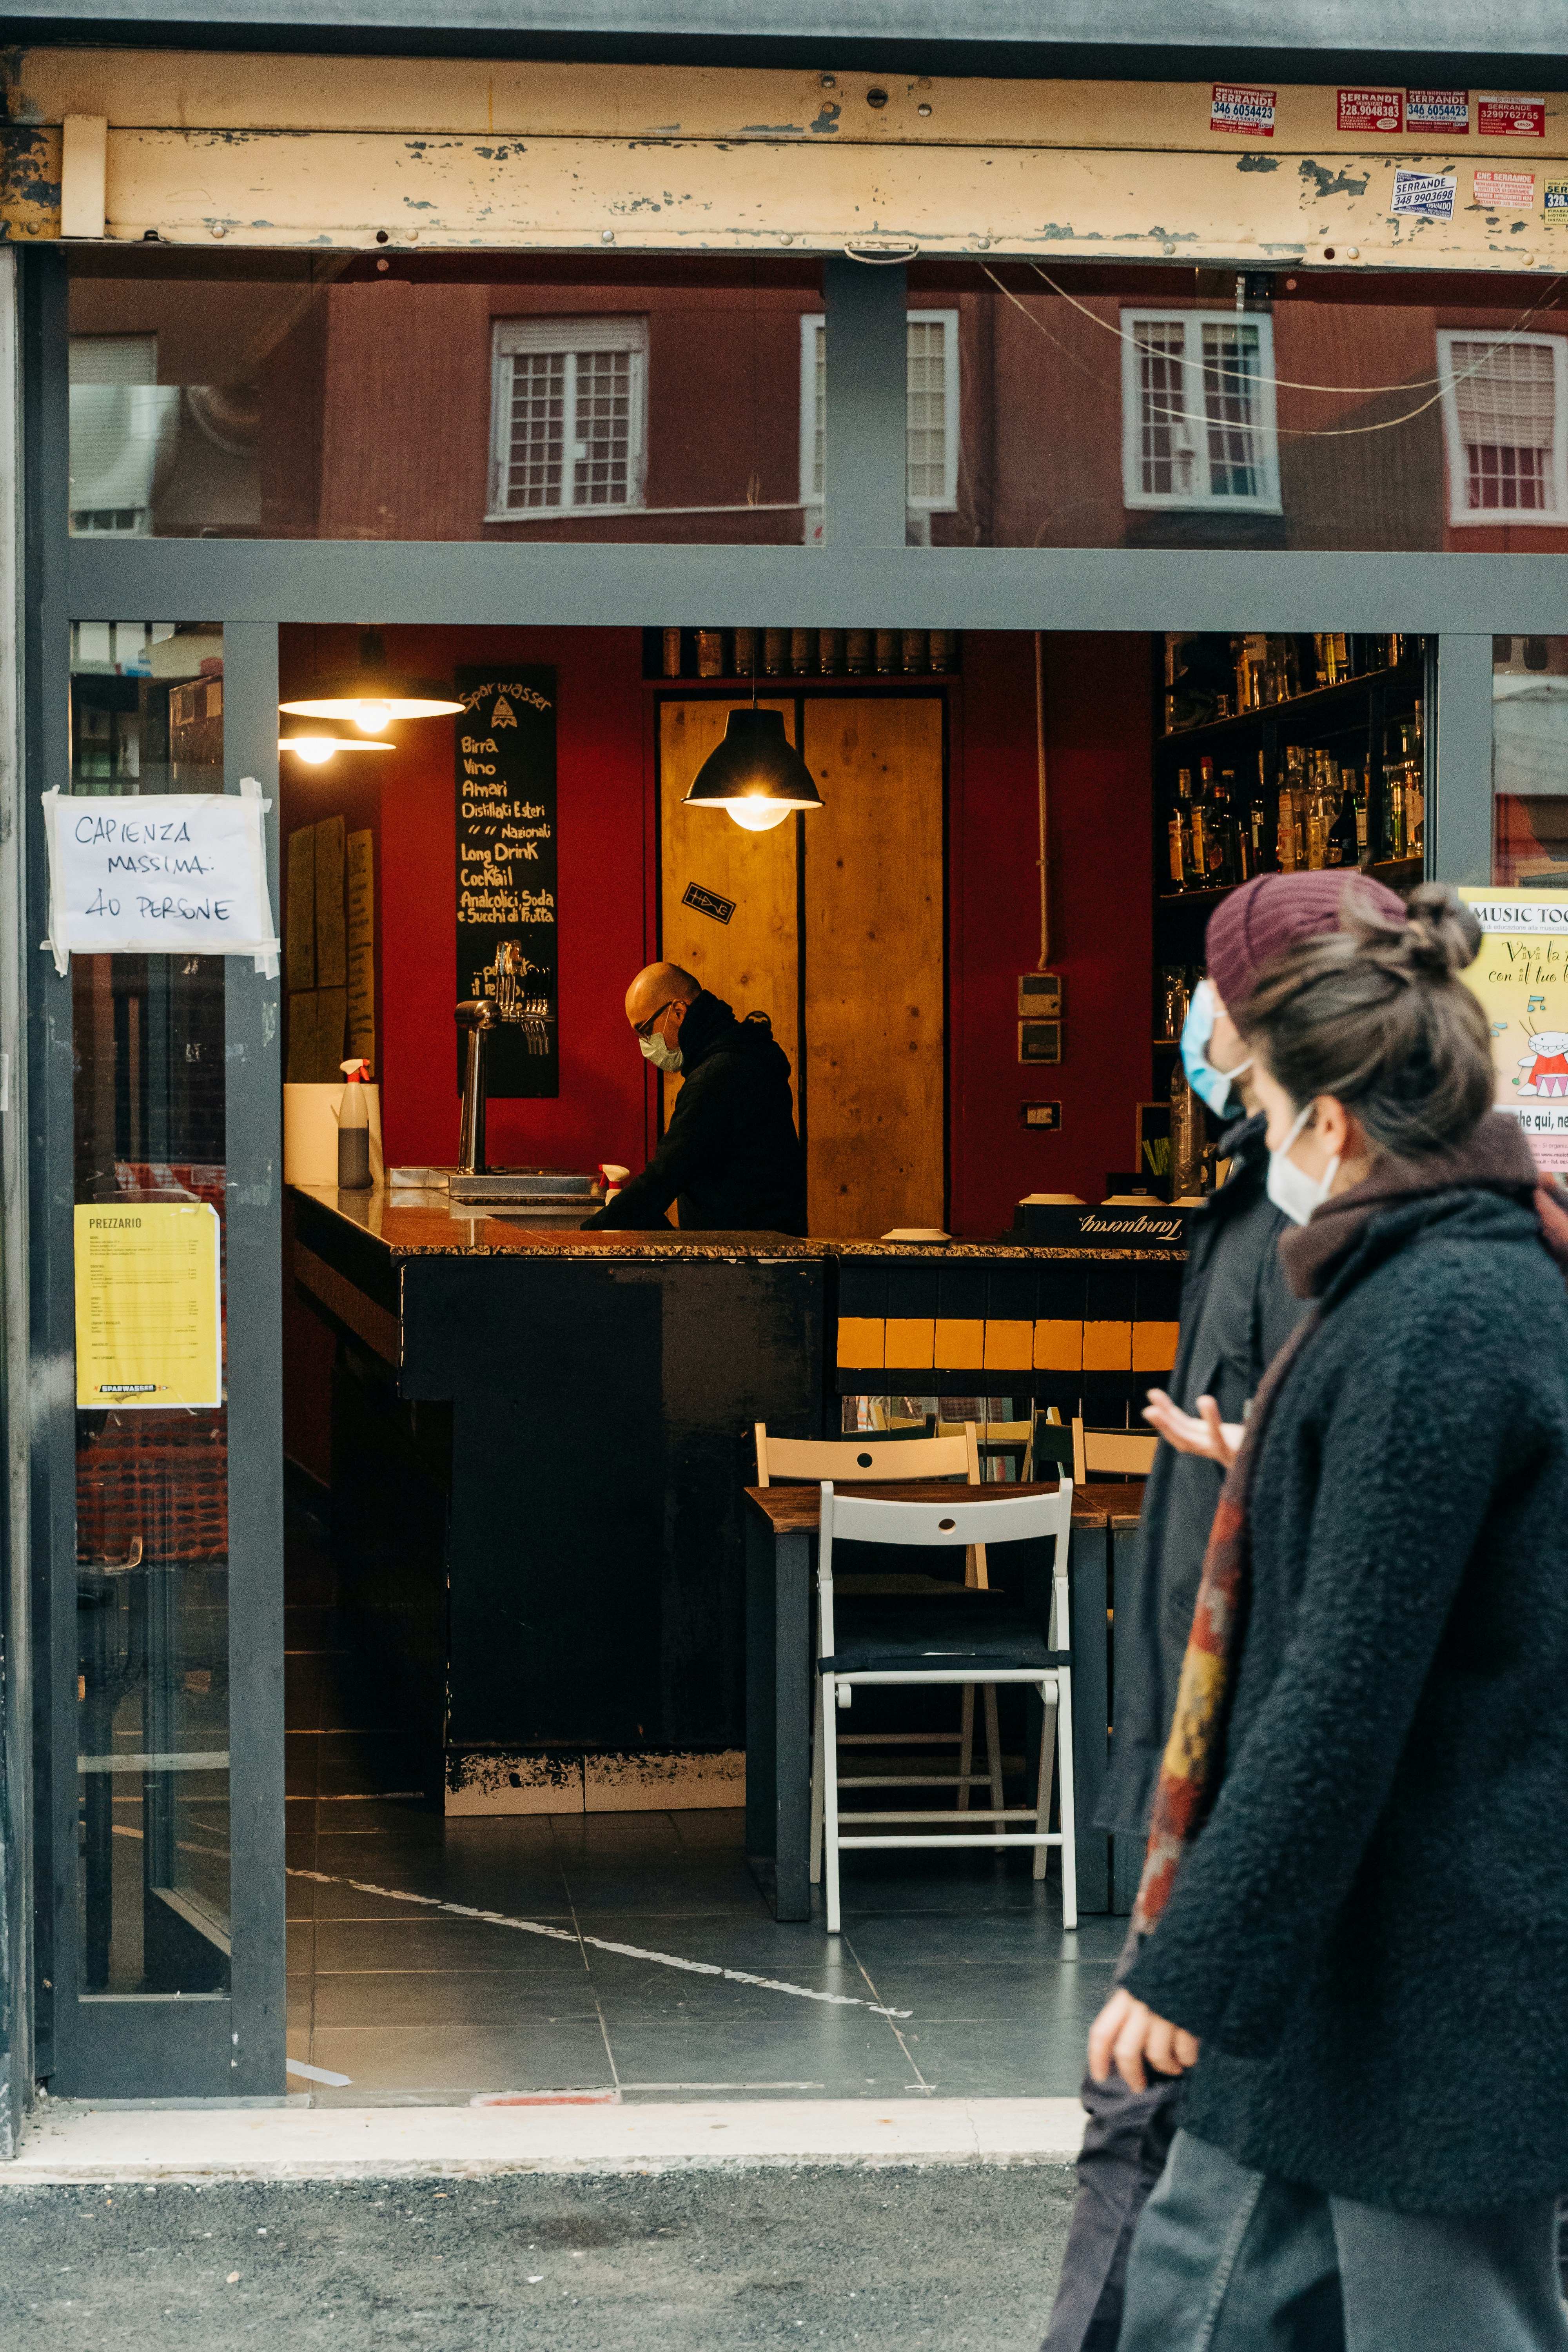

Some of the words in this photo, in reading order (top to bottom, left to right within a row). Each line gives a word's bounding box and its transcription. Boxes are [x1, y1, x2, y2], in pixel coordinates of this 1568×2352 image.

[1215, 93, 1273, 106] SERRANDE
[1340, 93, 1399, 105] SERRANDE
[1410, 95, 1465, 105] SERRANDE
[1214, 102, 1230, 114] 346
[1233, 104, 1272, 119] 6054423
[1340, 103, 1399, 118] 328.9048383
[1408, 104, 1425, 115] 346
[1427, 105, 1466, 116] 6054423
[1481, 110, 1538, 120] 3299762755
[1396, 178, 1446, 193] SERRANDE
[1477, 172, 1492, 180] CNC
[1494, 173, 1531, 183] SERRANDE
[1394, 195, 1412, 206] 348
[1414, 190, 1453, 203] 9903698
[1548, 194, 1568, 207] 328.
[1426, 202, 1451, 211] OSVALDO
[461, 735, 499, 754] Birra
[463, 758, 496, 775] Vino
[462, 779, 507, 797] Amari
[461, 802, 511, 819] Distillati
[514, 800, 545, 819] Esteri
[74, 815, 191, 844] CAPIENZA
[502, 823, 551, 839] Nazionali
[461, 842, 492, 869] Long
[85, 888, 121, 916] 40
[136, 896, 236, 920] PERSONE
[522, 889, 554, 908] Soda
[457, 911, 466, 922] e
[467, 907, 506, 924] Succhi
[507, 907, 519, 923] di
[521, 907, 554, 924] Frutta
[1473, 907, 1533, 922] MUSIC
[1502, 941, 1540, 962] Vivi
[1547, 940, 1560, 964] la
[1488, 971, 1512, 983] con
[1518, 962, 1532, 985] il
[1536, 965, 1557, 985] tuo
[1535, 1111, 1554, 1131] qui,
[89, 1218, 142, 1229] PREZZARIO
[1080, 1214, 1183, 1240] Tanqueray
